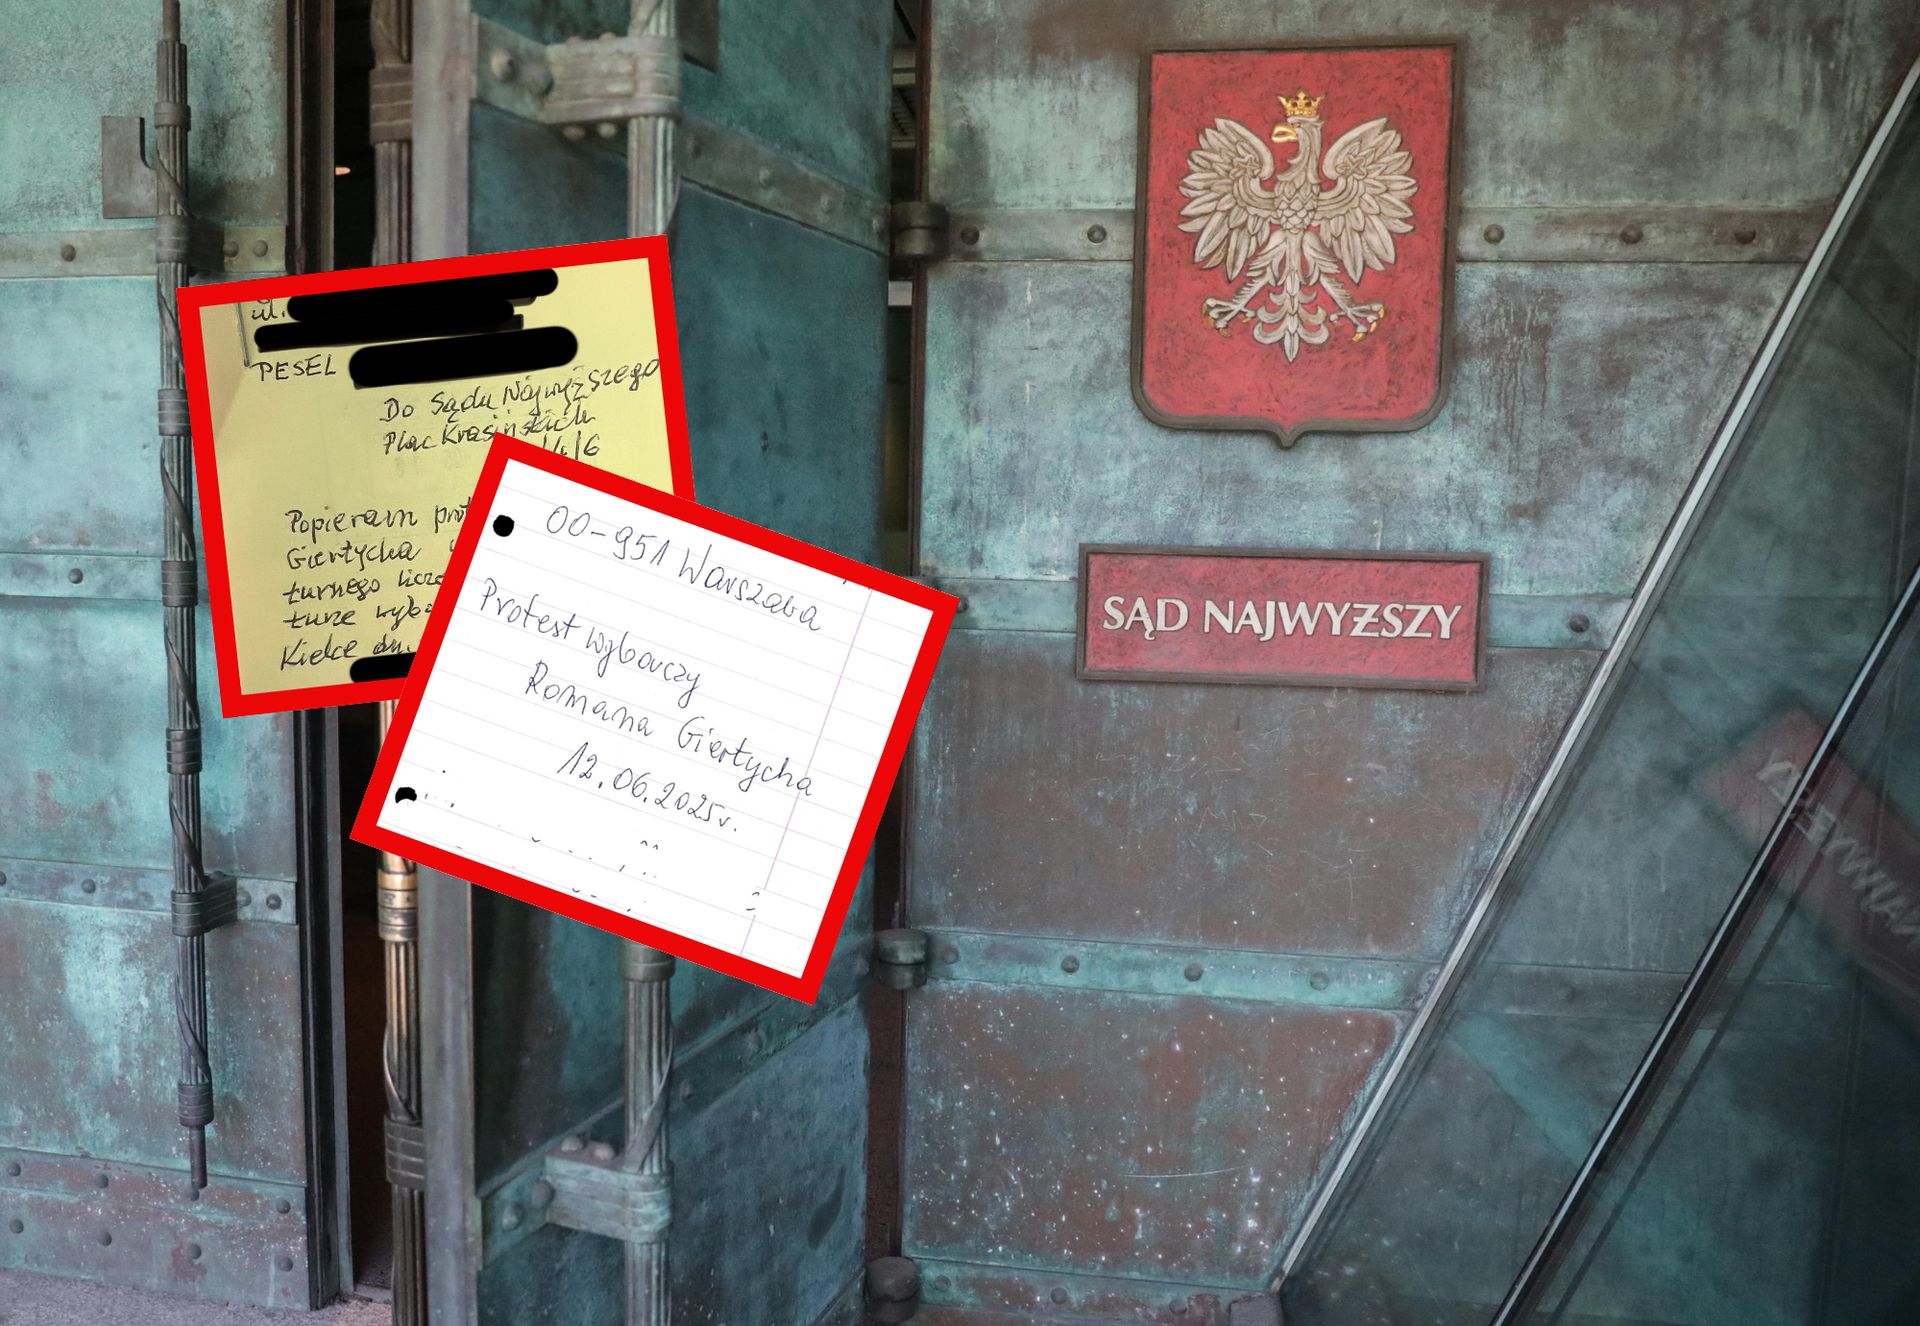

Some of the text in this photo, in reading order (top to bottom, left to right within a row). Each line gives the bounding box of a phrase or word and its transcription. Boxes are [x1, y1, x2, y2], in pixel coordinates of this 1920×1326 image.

[249, 354, 337, 381] PESEL
[380, 397, 414, 421] Do
[430, 386, 499, 422] Sądu
[384, 431, 437, 455] Plac
[285, 505, 418, 544] Popieram
[546, 505, 671, 566] 00-951
[286, 538, 422, 572] Giertycha
[283, 577, 381, 605] turnego
[479, 577, 582, 640] Protest
[283, 610, 356, 629] turze
[1103, 595, 1462, 642] SĄD NAJWYŻSZY
[280, 633, 358, 671] Kielce
[525, 659, 813, 797] Romana Giertycha
